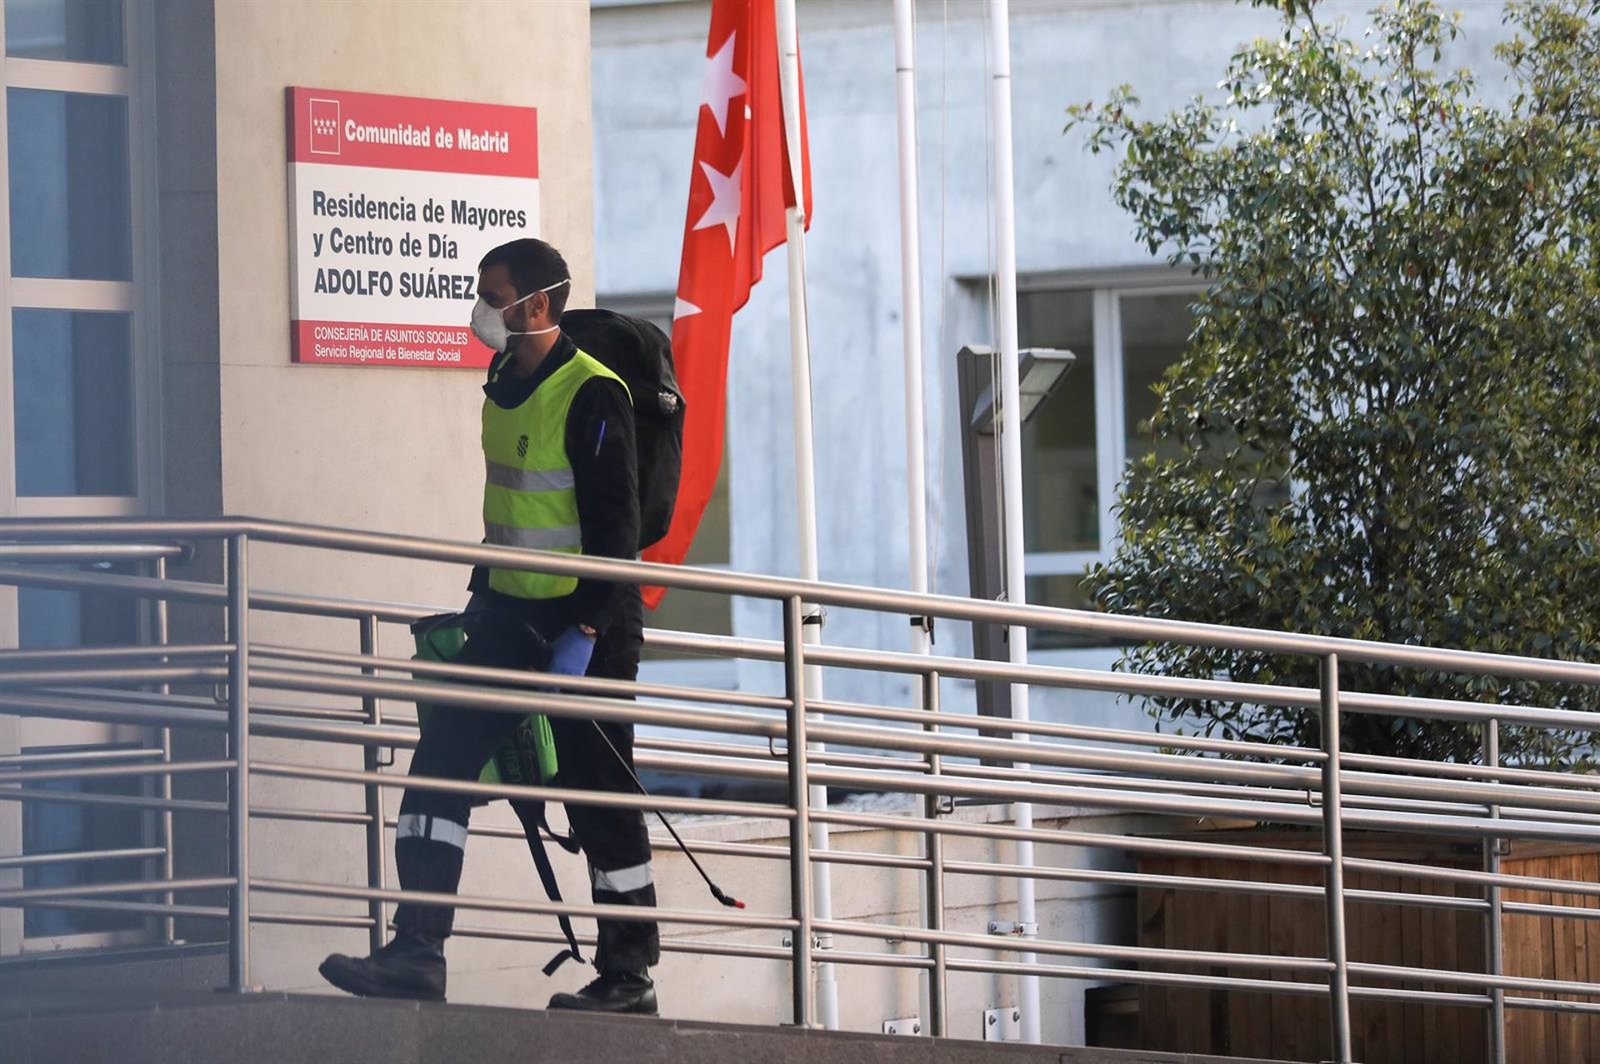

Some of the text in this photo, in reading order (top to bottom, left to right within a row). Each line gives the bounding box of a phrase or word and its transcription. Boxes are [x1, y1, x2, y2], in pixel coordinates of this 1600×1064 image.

[345, 119, 509, 153] Comunidad de Madrid
[313, 190, 527, 231] Residencia de Mayores
[313, 227, 458, 259] y Centro de Día
[314, 267, 475, 300] ADOLFO SUÁREZ
[314, 325, 468, 345] CONSEJERÍA DE ASUNTOS SOCIALES
[314, 344, 461, 362] Servicio Regional de Bienestar Social
